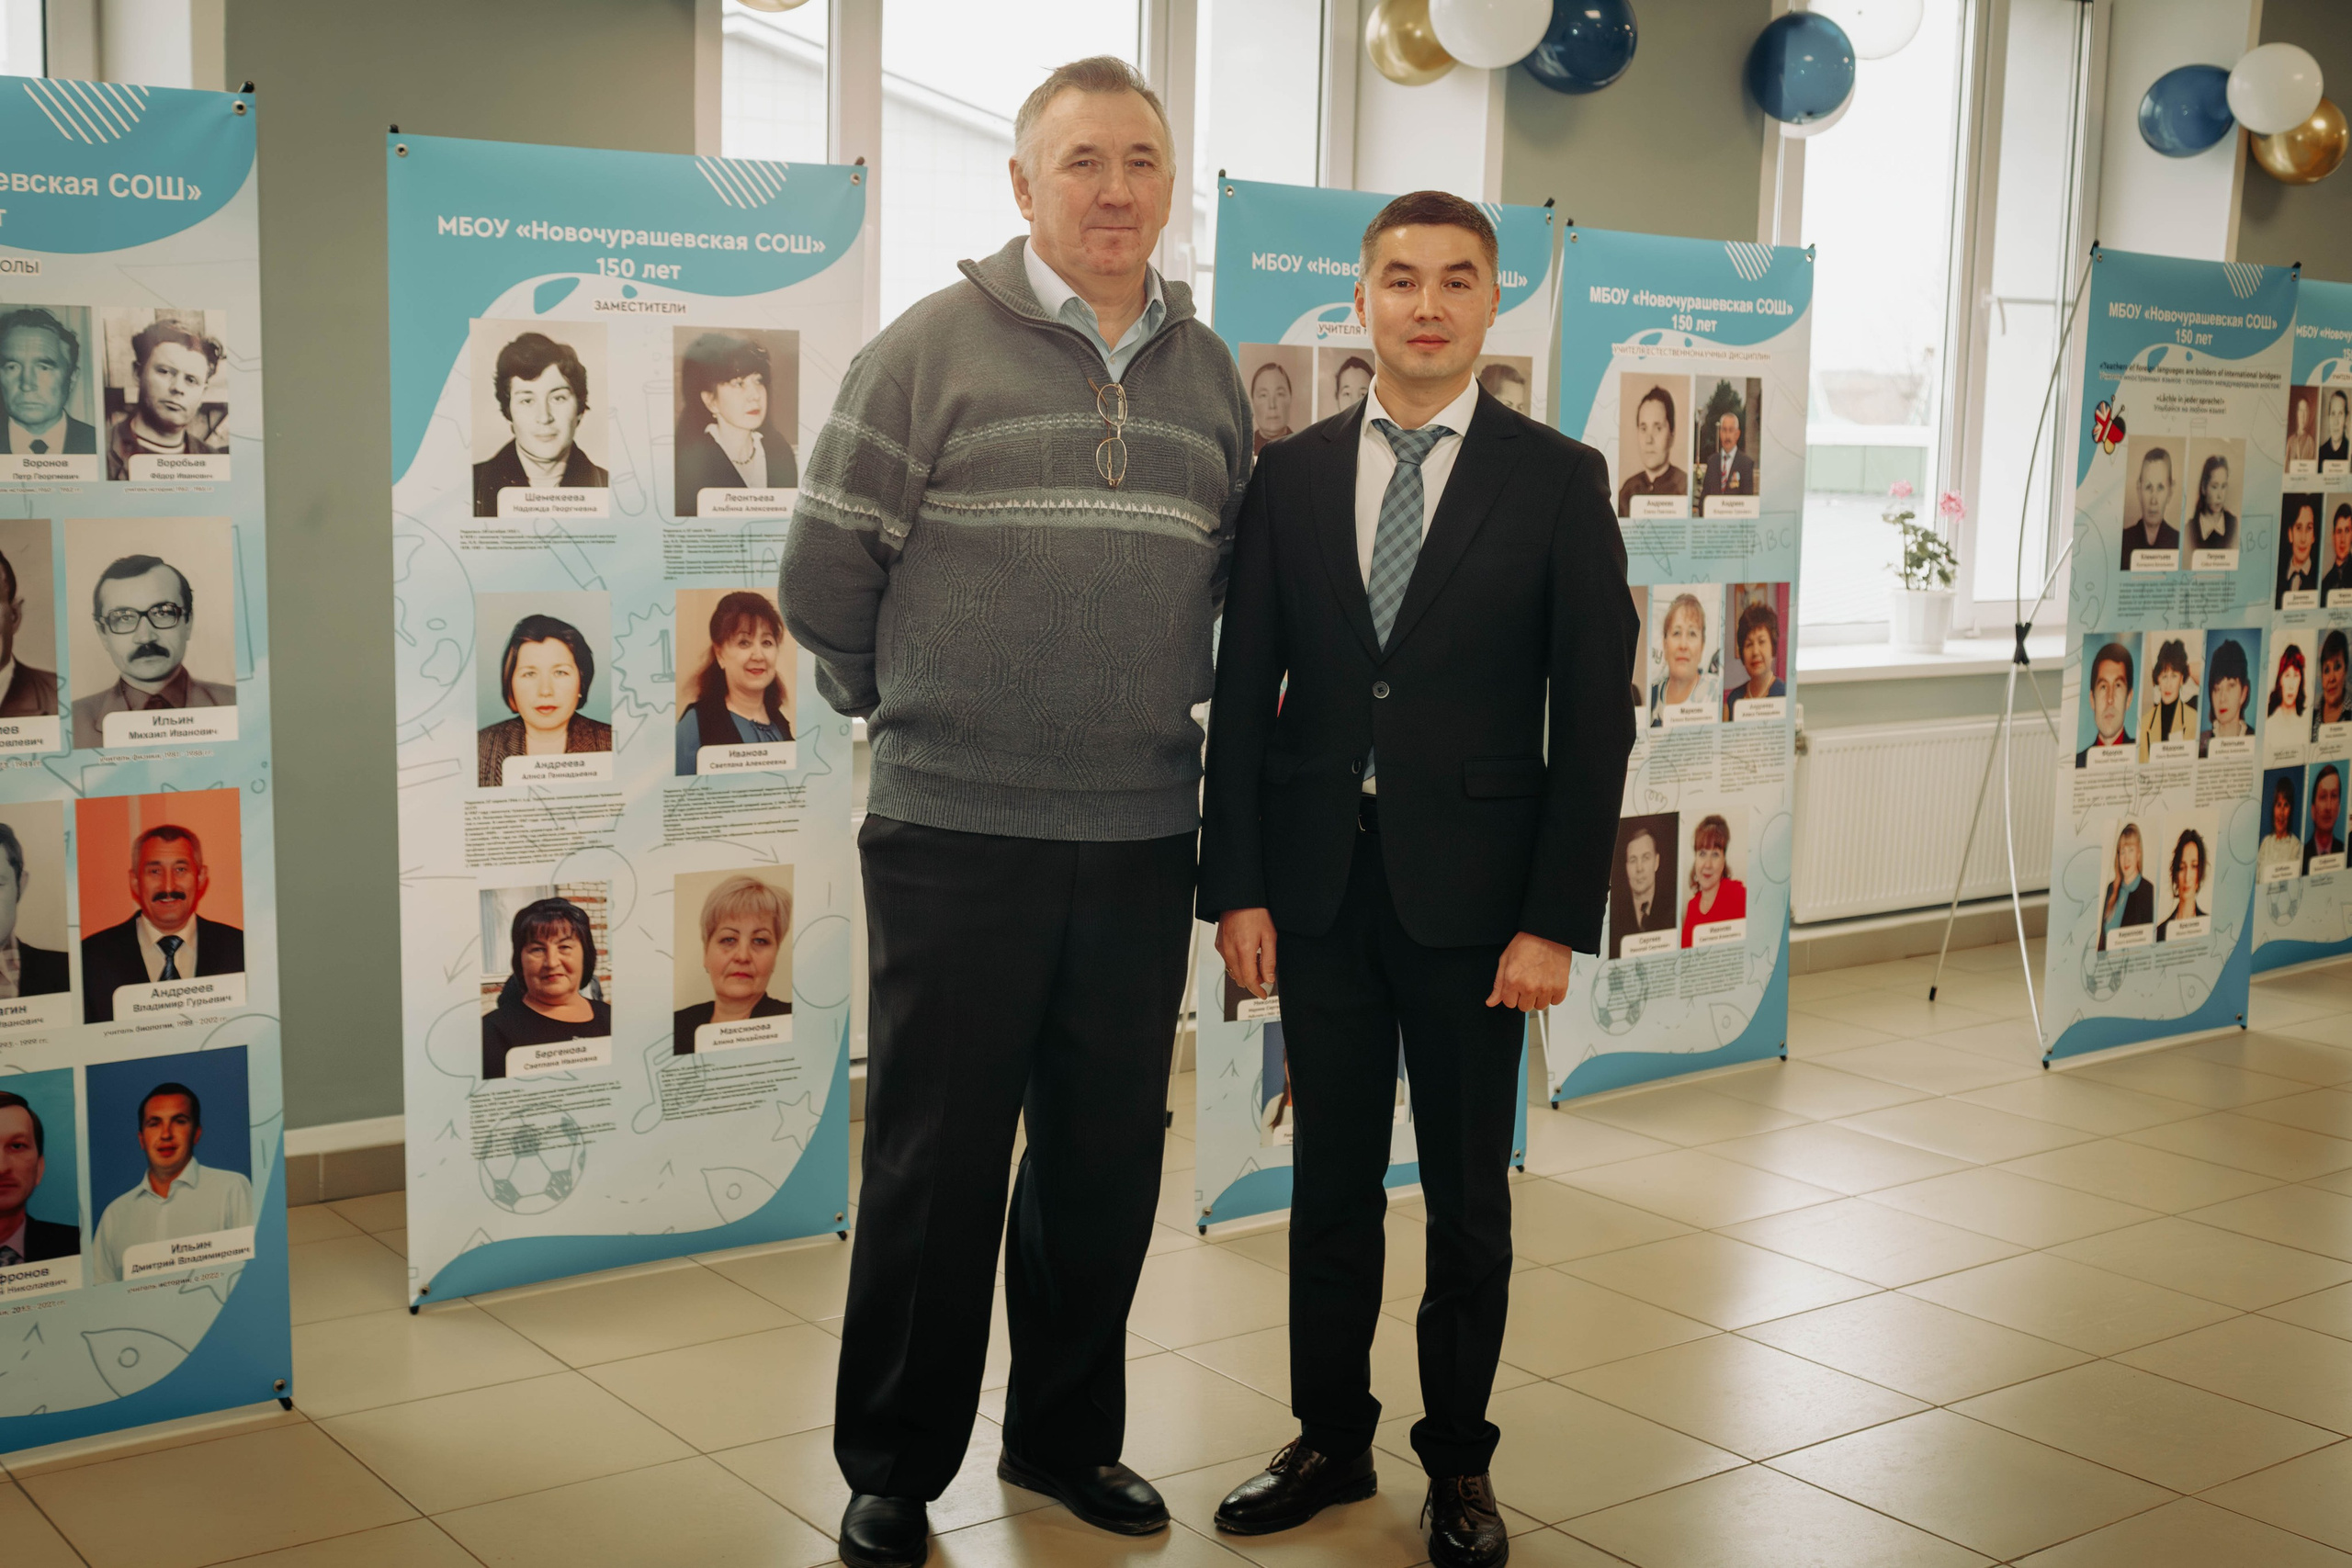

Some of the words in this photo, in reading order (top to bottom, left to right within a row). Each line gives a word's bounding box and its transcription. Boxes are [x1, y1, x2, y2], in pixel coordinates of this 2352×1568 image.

[108, 173, 202, 200] СОШ»
[438, 215, 510, 238] МБОУ
[516, 221, 748, 251] «Новочурашевская
[755, 231, 825, 254] СОШ»
[596, 258, 635, 278] 150
[642, 263, 682, 280] лет
[1251, 252, 1303, 273] МБОУ
[594, 300, 687, 314] ЗАМЕСТИТЕЛИ
[1589, 286, 1629, 305] МБОУ
[1633, 289, 1753, 313] «Новочурашевская
[1756, 298, 1794, 316] СОШ»
[2109, 302, 2142, 320] МБОУ
[2144, 306, 2244, 329] «Новочурашевская
[2245, 313, 2278, 331] СОШ»
[1318, 323, 1361, 335] УЧИТЕЛЯ
[1671, 314, 1693, 331] 150
[1696, 318, 1718, 333] лет
[2175, 328, 2194, 344] 150
[2196, 332, 2213, 345] лет
[2296, 325, 2319, 339] МБОУ
[23, 458, 68, 468] Воронов
[157, 458, 206, 468] Воробьев
[725, 493, 775, 502] Леонтьева
[153, 716, 194, 726] Ильин
[129, 731, 166, 739] Михаил
[170, 728, 218, 737] Иванович
[729, 750, 768, 758] Иванова
[535, 760, 585, 770] Андреева
[133, 1001, 183, 1012] Владимир
[187, 995, 232, 1007] Гурьевич
[719, 1023, 771, 1035] Максимова
[535, 1046, 587, 1059] Бергенова
[171, 1241, 211, 1254] Ильин
[131, 1259, 175, 1273] Дмитрий
[178, 1247, 250, 1264] Владимирович
[7, 1280, 67, 1293] Николаевич
